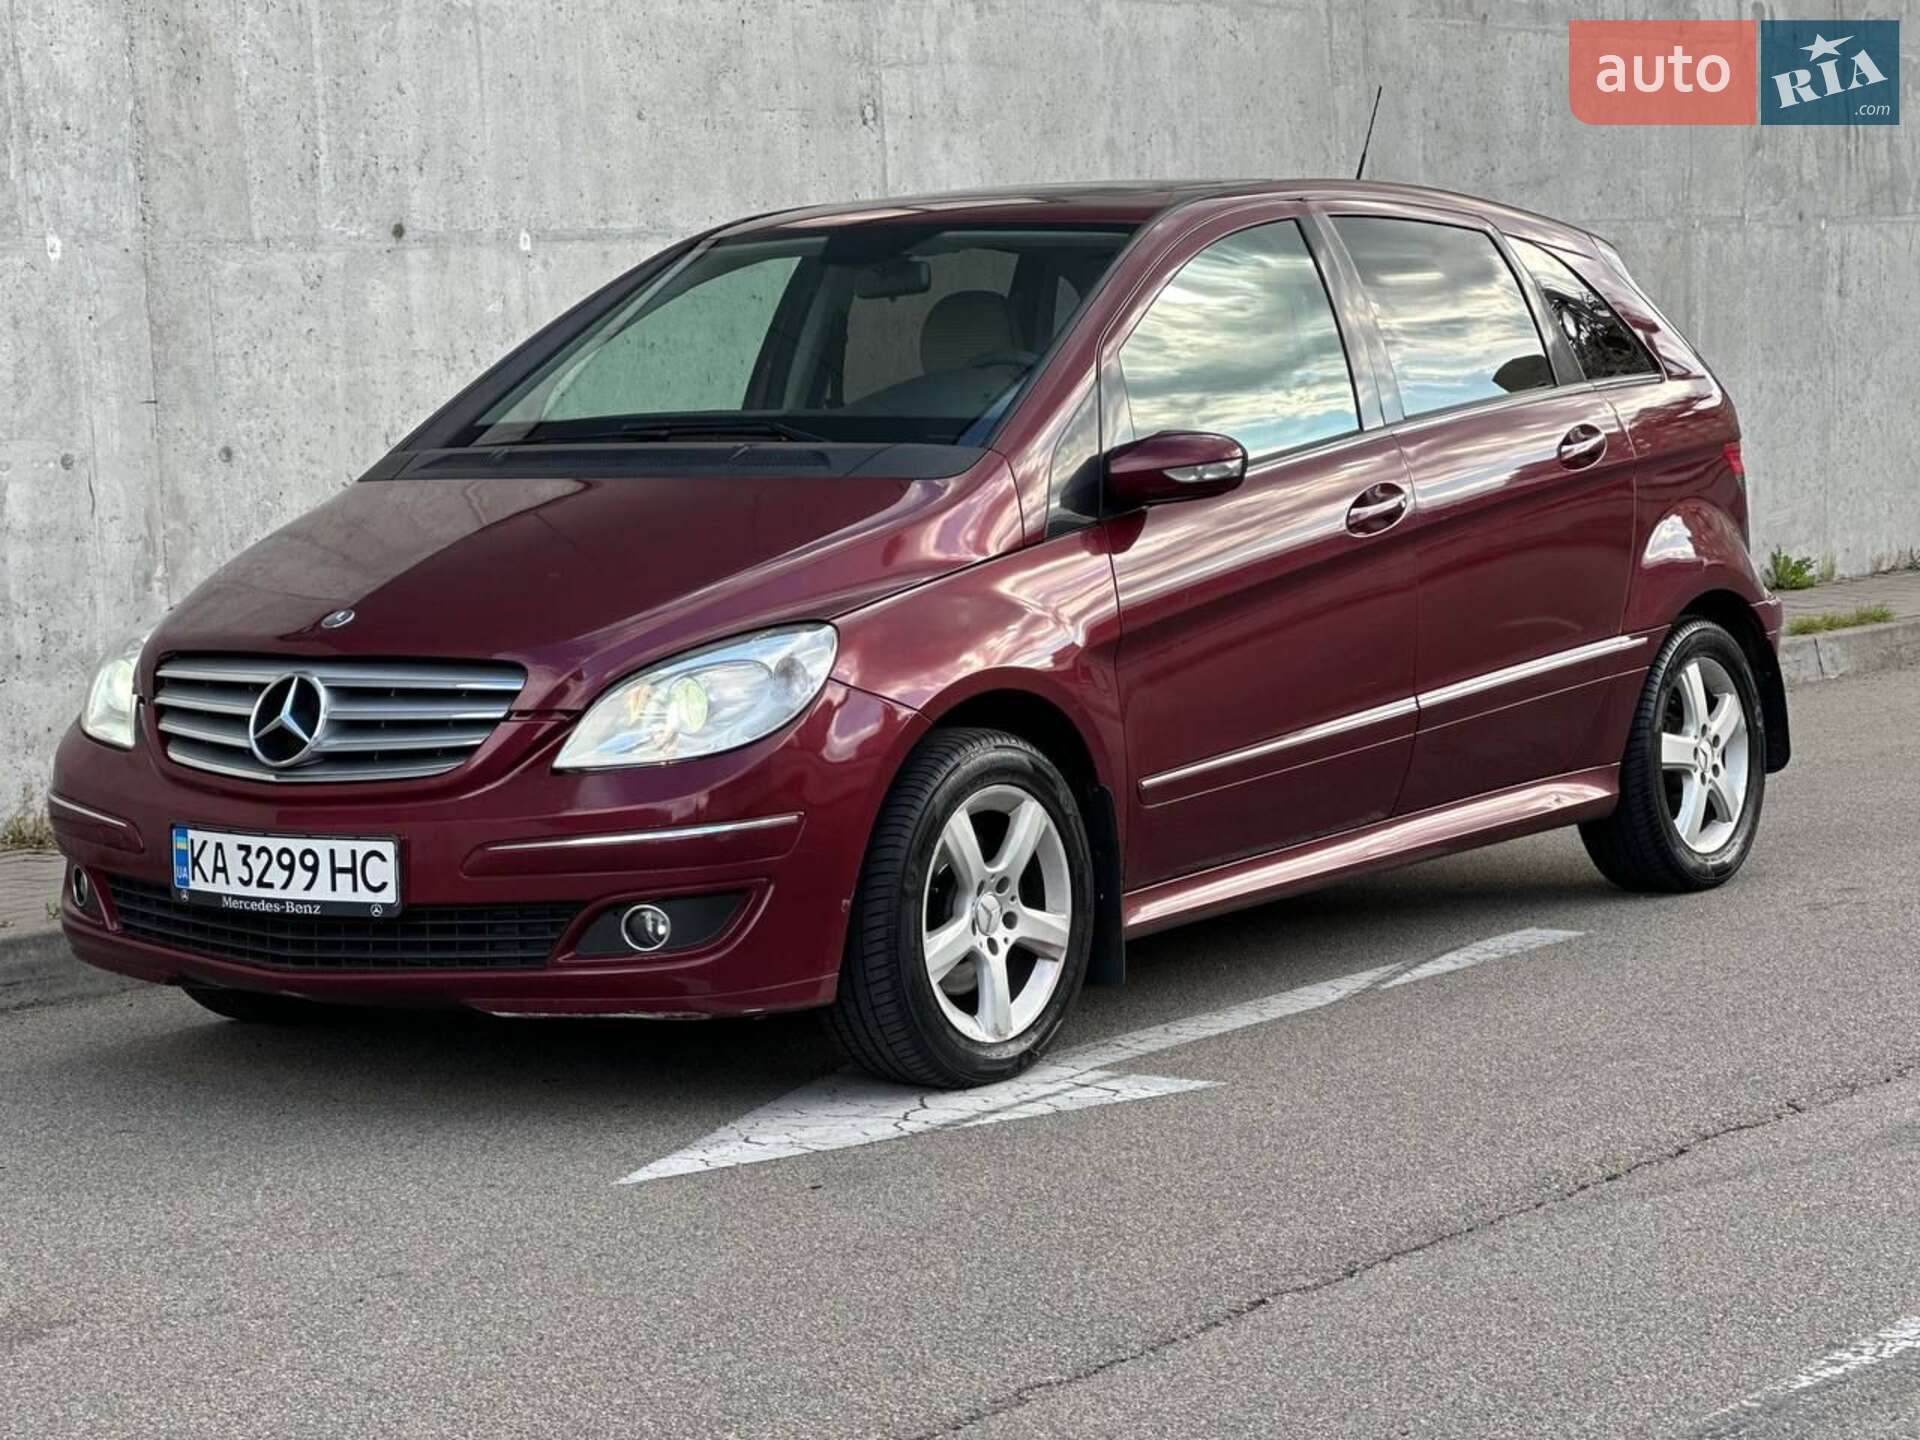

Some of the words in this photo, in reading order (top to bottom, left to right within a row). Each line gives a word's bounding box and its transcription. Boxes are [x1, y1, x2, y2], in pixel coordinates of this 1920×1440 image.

[176, 866, 189, 879] UA
[190, 838, 231, 886] KA
[236, 843, 320, 892] 3299
[329, 848, 389, 893] HC
[221, 896, 322, 915] Mercedes-Benz
